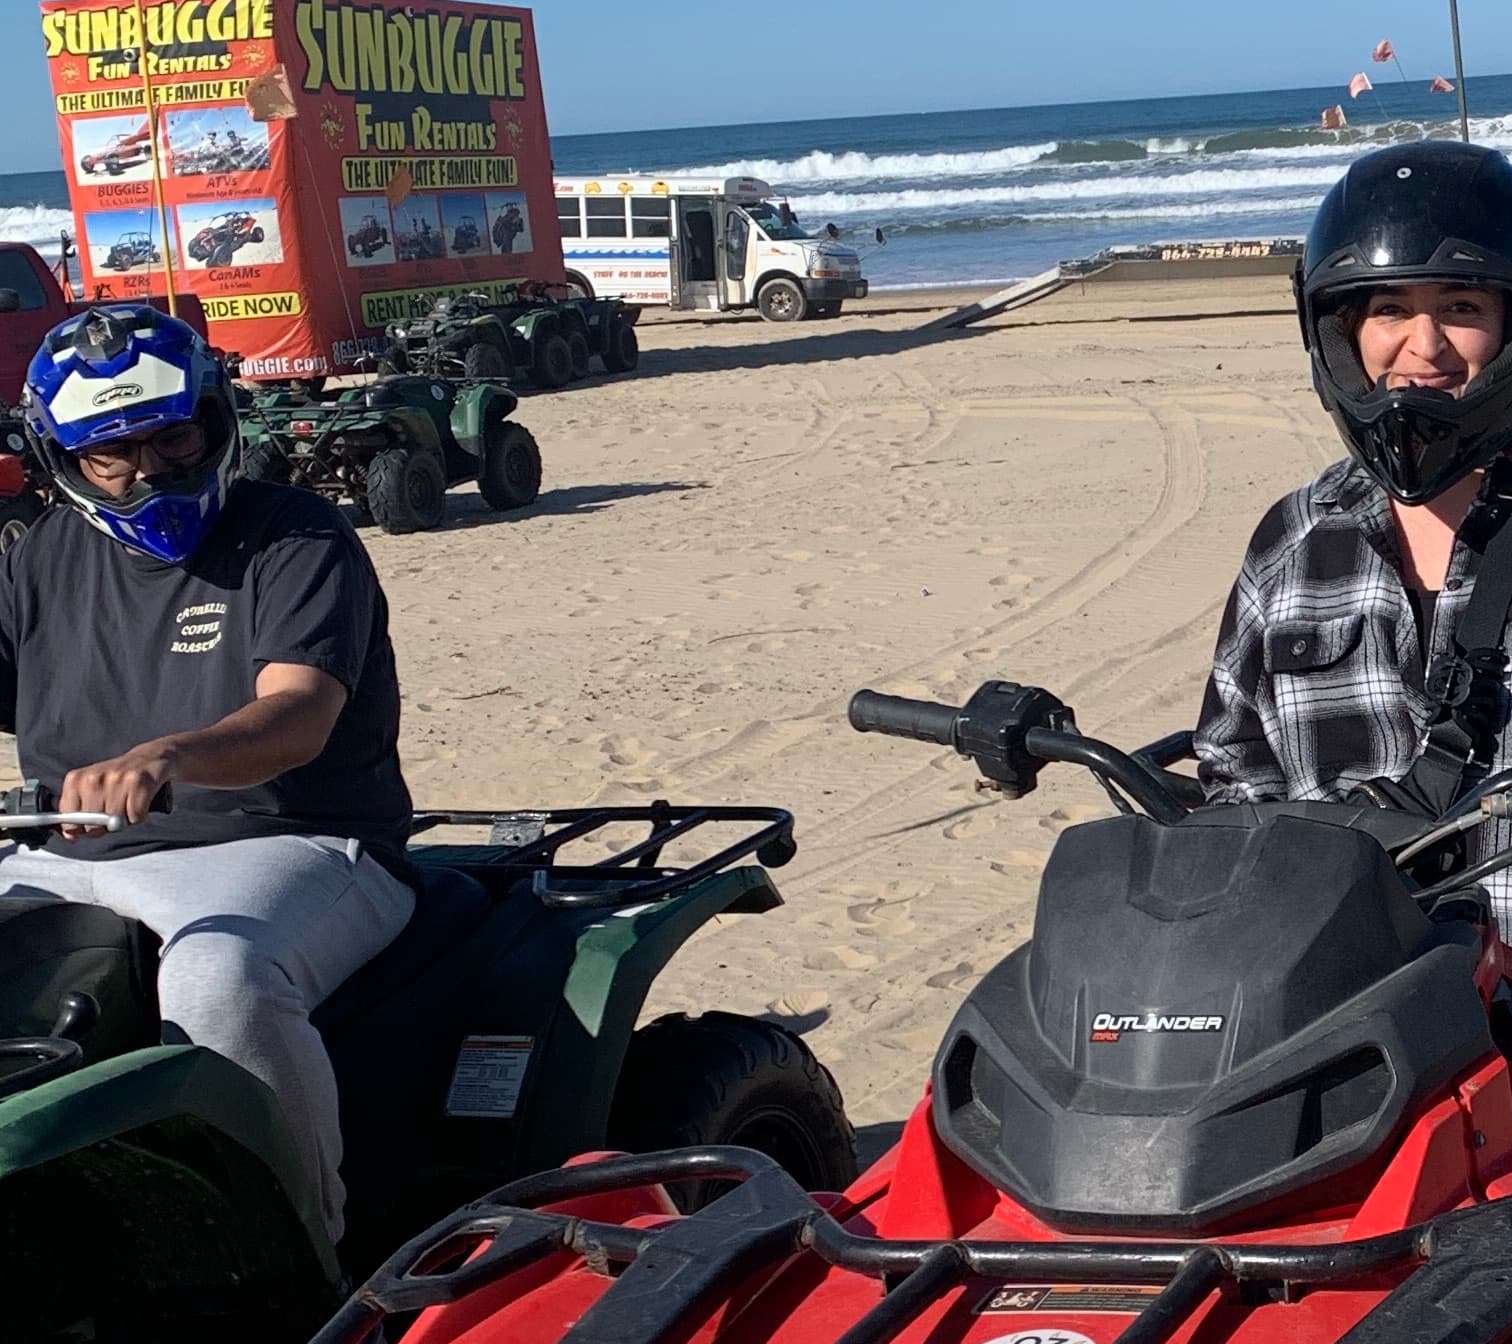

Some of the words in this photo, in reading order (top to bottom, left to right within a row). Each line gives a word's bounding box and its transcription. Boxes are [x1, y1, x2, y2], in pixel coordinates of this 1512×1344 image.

[60, 95, 87, 111] THE
[91, 87, 160, 109] ULTIMAE
[165, 81, 224, 102] FAMILY
[230, 80, 250, 97] FU
[412, 106, 496, 150] RENTALS
[346, 160, 371, 188] THE
[440, 159, 482, 185] FAMILY
[486, 159, 514, 184] FUN!
[98, 183, 149, 197] BUGGIES
[209, 269, 261, 282] CanAMs
[201, 300, 240, 318] RIDE
[244, 295, 293, 315] NOW
[367, 295, 405, 323] RENT
[1092, 1013, 1223, 1031] OUTLANDER
